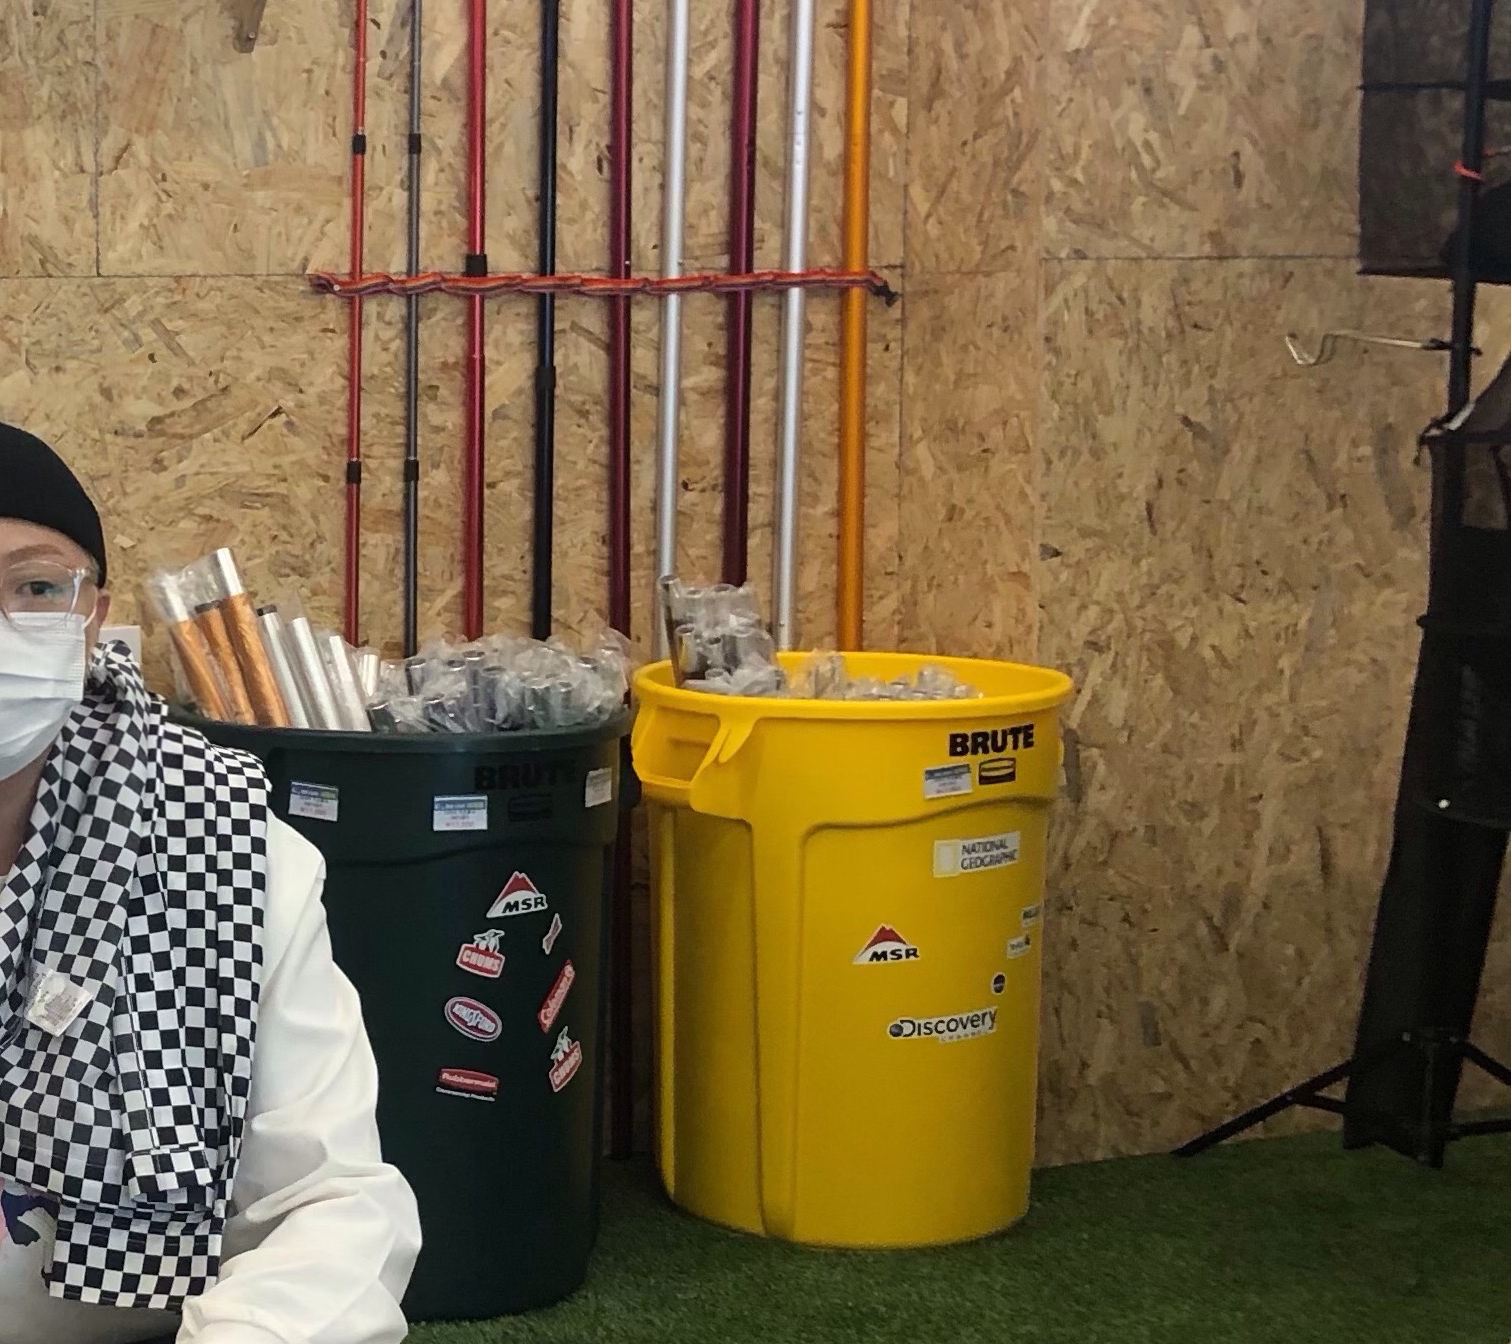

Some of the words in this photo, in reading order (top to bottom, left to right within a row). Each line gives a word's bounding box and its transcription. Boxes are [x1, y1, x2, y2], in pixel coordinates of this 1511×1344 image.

[949, 723, 1035, 757] BRUTE
[961, 838, 1009, 856] NATIONAL
[501, 896, 545, 914] MSR
[868, 947, 920, 962] MSR
